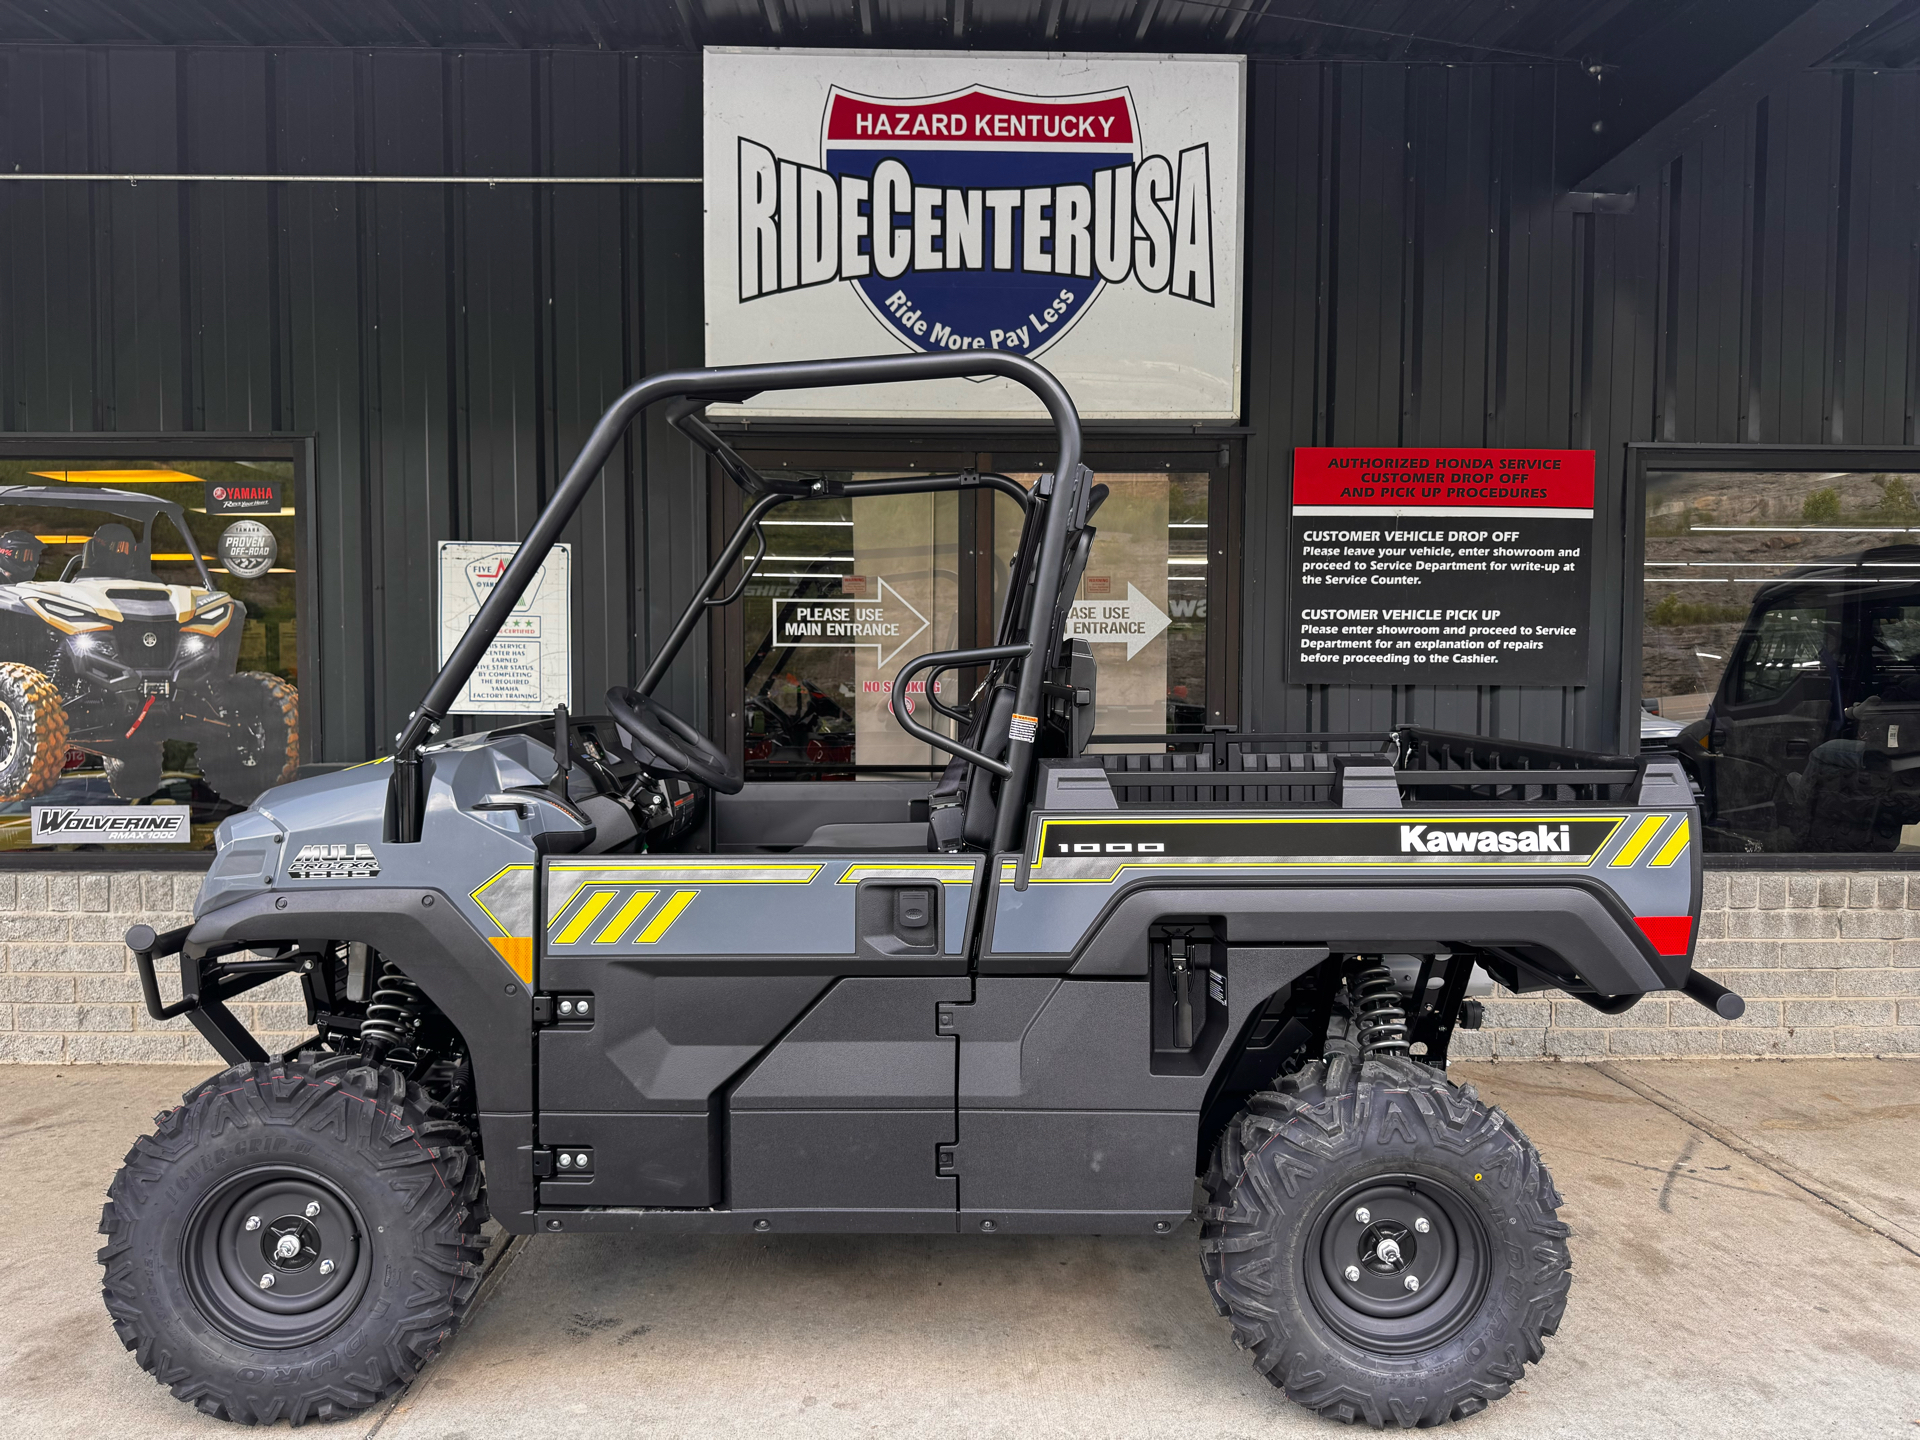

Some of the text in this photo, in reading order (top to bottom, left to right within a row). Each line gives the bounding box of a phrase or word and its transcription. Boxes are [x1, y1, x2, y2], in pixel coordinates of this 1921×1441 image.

[857, 114, 1115, 137] HAZARD KENTUCKY
[885, 287, 1075, 350] Ride More Pay Less
[1328, 458, 1561, 470] AUTHORIZED HONDA SERVICE
[1361, 473, 1529, 484] CUSTOMER DROP OFF
[227, 488, 273, 499] YAMAHA
[1340, 487, 1547, 499] AND PICK UP PROCEDURES
[223, 500, 241, 508] Revs
[225, 537, 265, 547] PROVEN
[1304, 531, 1519, 541] CUSTOMER VEHICLE DROP OFF
[230, 547, 270, 555] OFF-ROAD
[1303, 547, 1580, 558] Please leave your vehicle, enter showroom and
[1303, 561, 1575, 573] proceed to Service Department for write-up at
[1302, 575, 1421, 584] the Service Counter.
[797, 608, 883, 621] PLEASE USE
[1067, 607, 1130, 619] ASE USE
[1302, 609, 1500, 620] CUSTOMER VEHICLE PICK UP
[785, 623, 899, 636] MAIN ENTRANCE
[1073, 622, 1145, 634] ENTRANCE
[1302, 625, 1338, 633] Please
[1342, 626, 1373, 634] enter
[1377, 625, 1439, 634] showroom
[1443, 626, 1466, 634] and
[1469, 626, 1516, 636] proceed
[1536, 626, 1576, 635] Service
[1301, 639, 1372, 650] Department
[1375, 639, 1393, 648] for
[1415, 640, 1484, 651] explanation
[1488, 640, 1500, 648] of
[1504, 640, 1543, 651] repairs
[1301, 653, 1498, 665] before proceeding to the Cashier.
[864, 681, 880, 692] NO
[37, 808, 185, 835] WOLVERINE
[1401, 825, 1570, 852] Kawasaki
[293, 843, 378, 862] MULE
[1059, 843, 1164, 852] 1000
[288, 862, 380, 871] PRO-FXR
[1464, 1241, 1525, 1365] DURO
[236, 1328, 368, 1386] DURO
